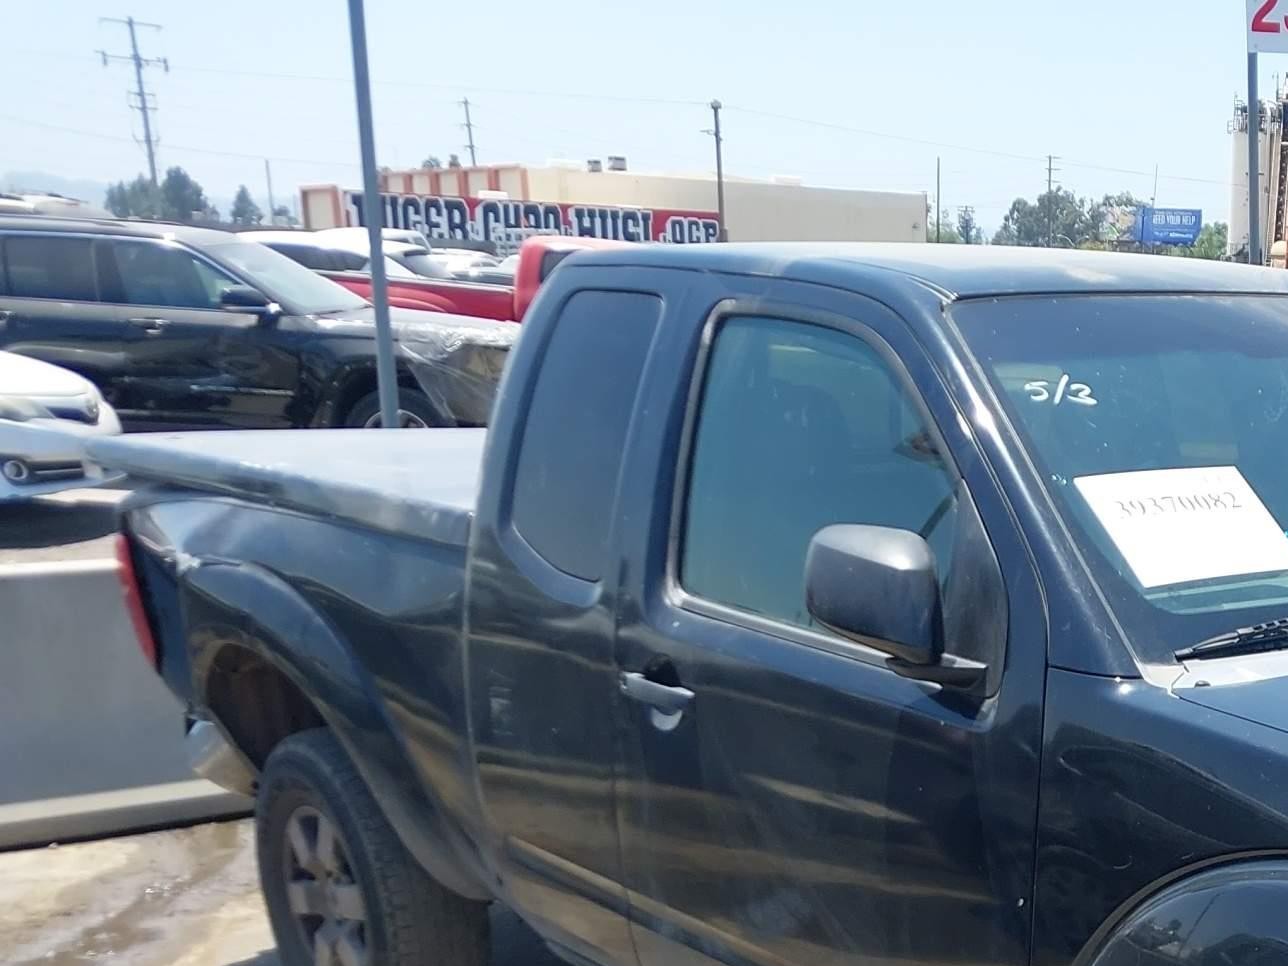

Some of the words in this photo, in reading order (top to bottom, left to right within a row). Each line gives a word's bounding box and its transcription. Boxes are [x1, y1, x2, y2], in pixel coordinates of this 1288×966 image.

[1182, 215, 1196, 226] HELP
[1024, 374, 1098, 405] 5/3
[1115, 491, 1243, 519] 39370082
